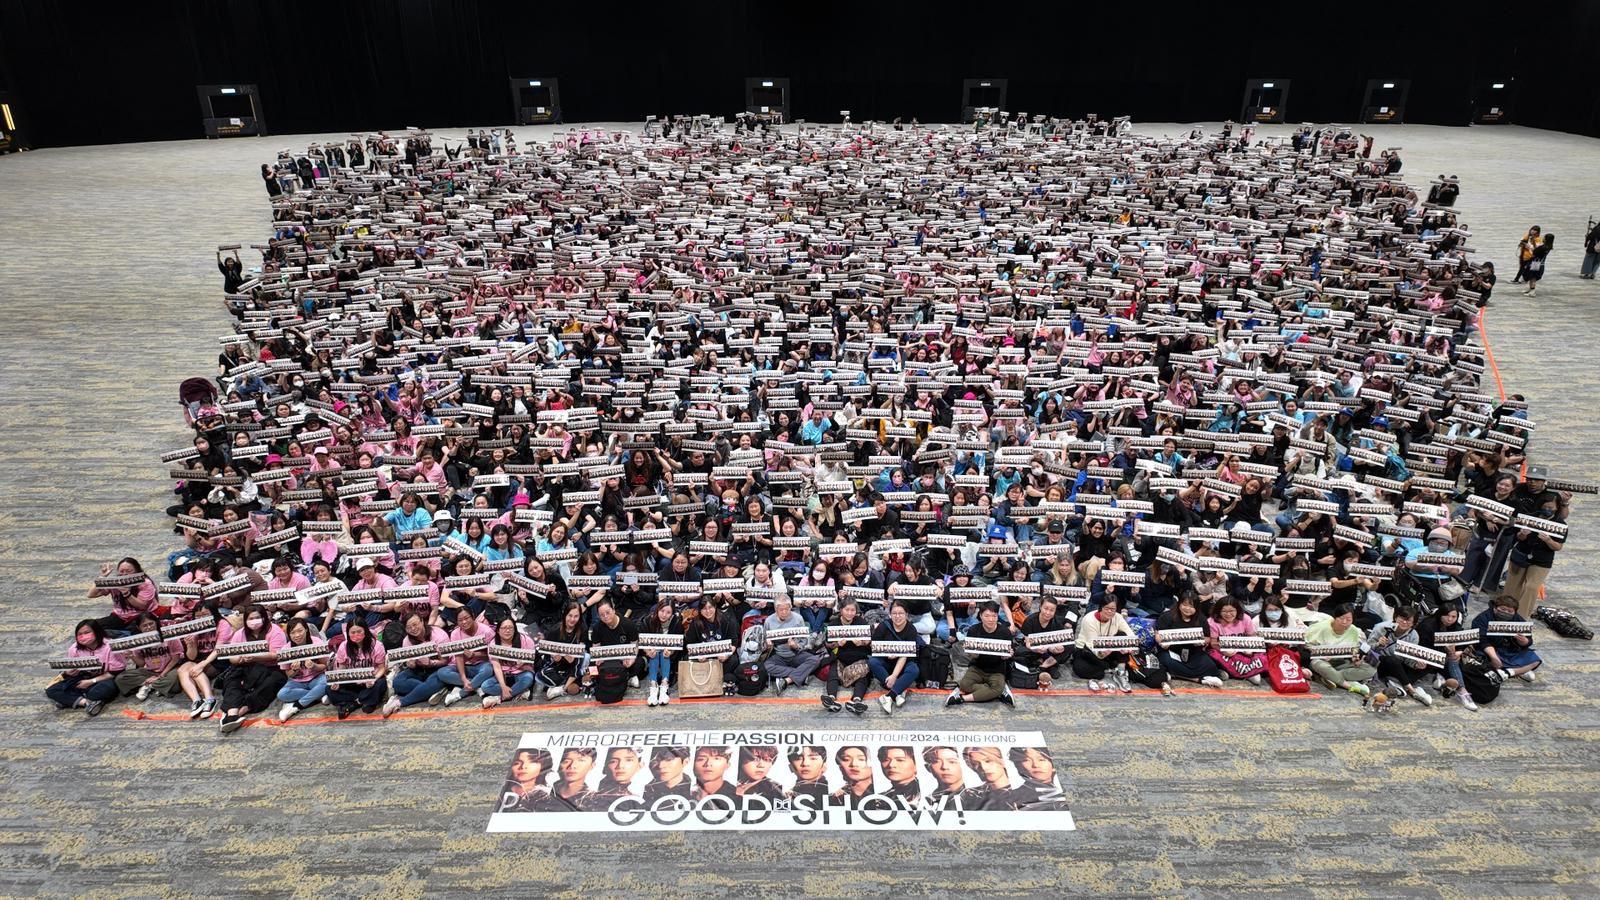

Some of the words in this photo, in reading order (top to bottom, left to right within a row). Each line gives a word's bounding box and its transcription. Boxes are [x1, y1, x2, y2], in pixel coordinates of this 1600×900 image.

[547, 734, 630, 747] MIRROR
[630, 733, 683, 745] FEEL
[722, 732, 814, 745] PASSION
[910, 734, 940, 742] 2024
[948, 735, 981, 743] HONG
[984, 735, 1017, 743] KONG
[607, 794, 773, 826] GOOD
[792, 793, 966, 826] SHOW!
